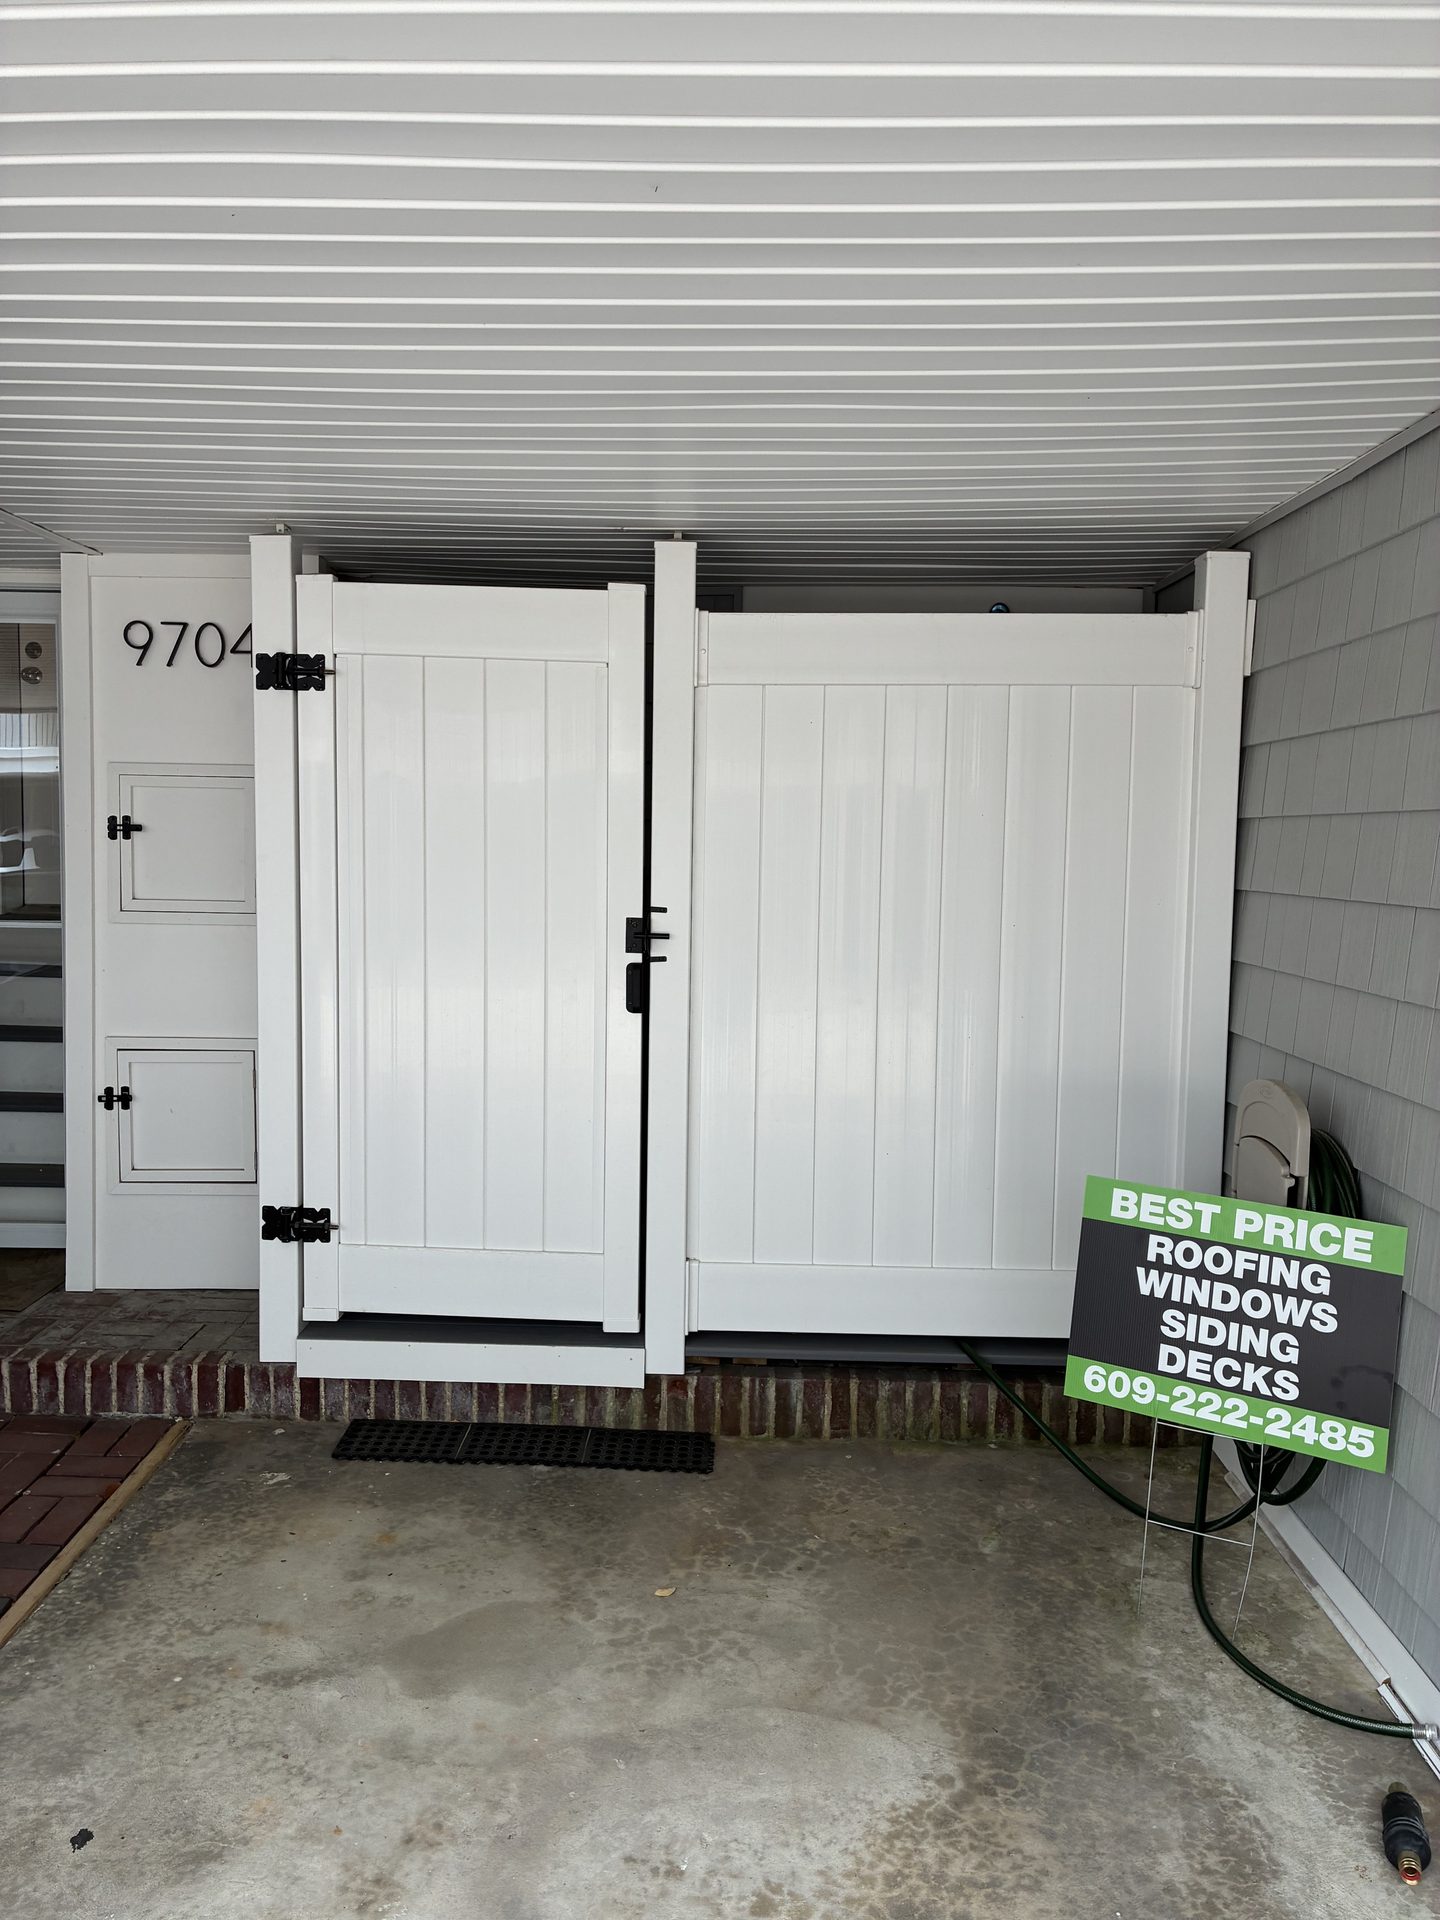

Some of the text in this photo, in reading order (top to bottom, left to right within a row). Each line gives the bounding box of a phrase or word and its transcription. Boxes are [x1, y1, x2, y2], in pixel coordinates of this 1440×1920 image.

[123, 620, 252, 668] 9704
[1110, 1187, 1374, 1263] BEST PRICE
[1147, 1233, 1332, 1296] ROOFING
[1136, 1266, 1338, 1333] WINDOWS
[1160, 1308, 1300, 1365] SIDING
[1157, 1343, 1300, 1401] DECKS
[1083, 1365, 1375, 1458] 609-222-2485
